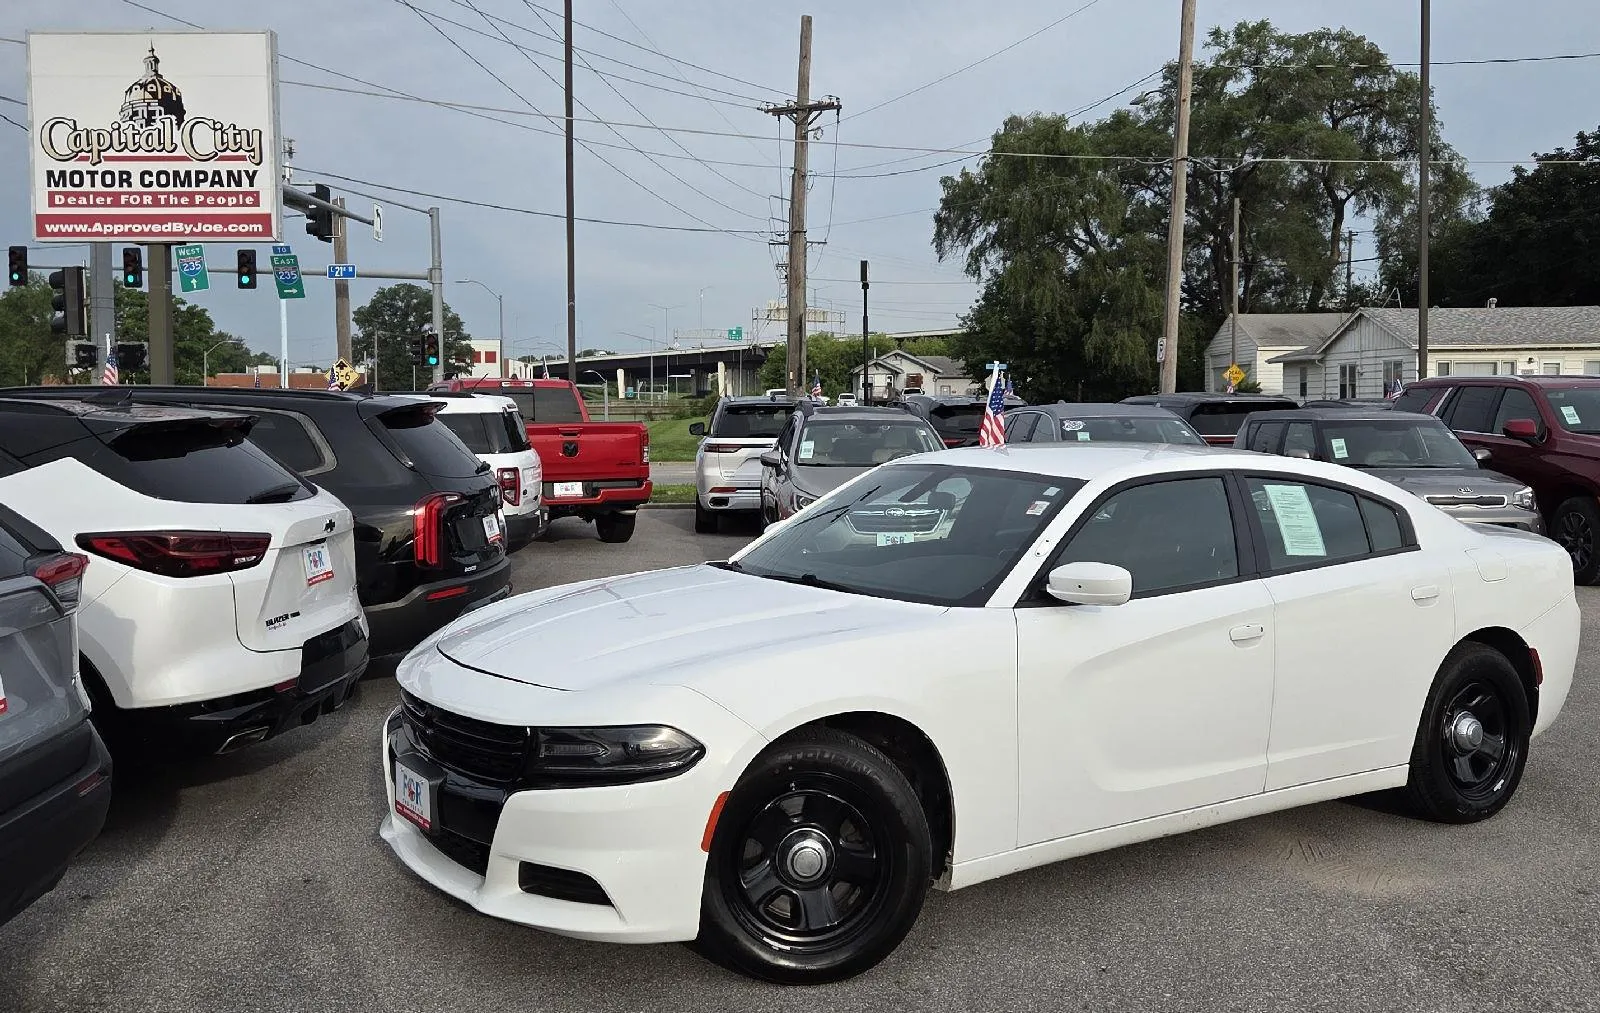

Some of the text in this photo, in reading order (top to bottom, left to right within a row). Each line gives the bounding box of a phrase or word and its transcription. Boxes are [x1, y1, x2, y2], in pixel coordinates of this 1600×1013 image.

[40, 117, 263, 166] Capital City
[46, 170, 258, 188] MOTOR COMPANY
[54, 194, 255, 207] Dealer FOR The People
[44, 222, 263, 235] www.ApprovedByJoe.com
[183, 262, 201, 272] 235
[278, 271, 298, 280] 235
